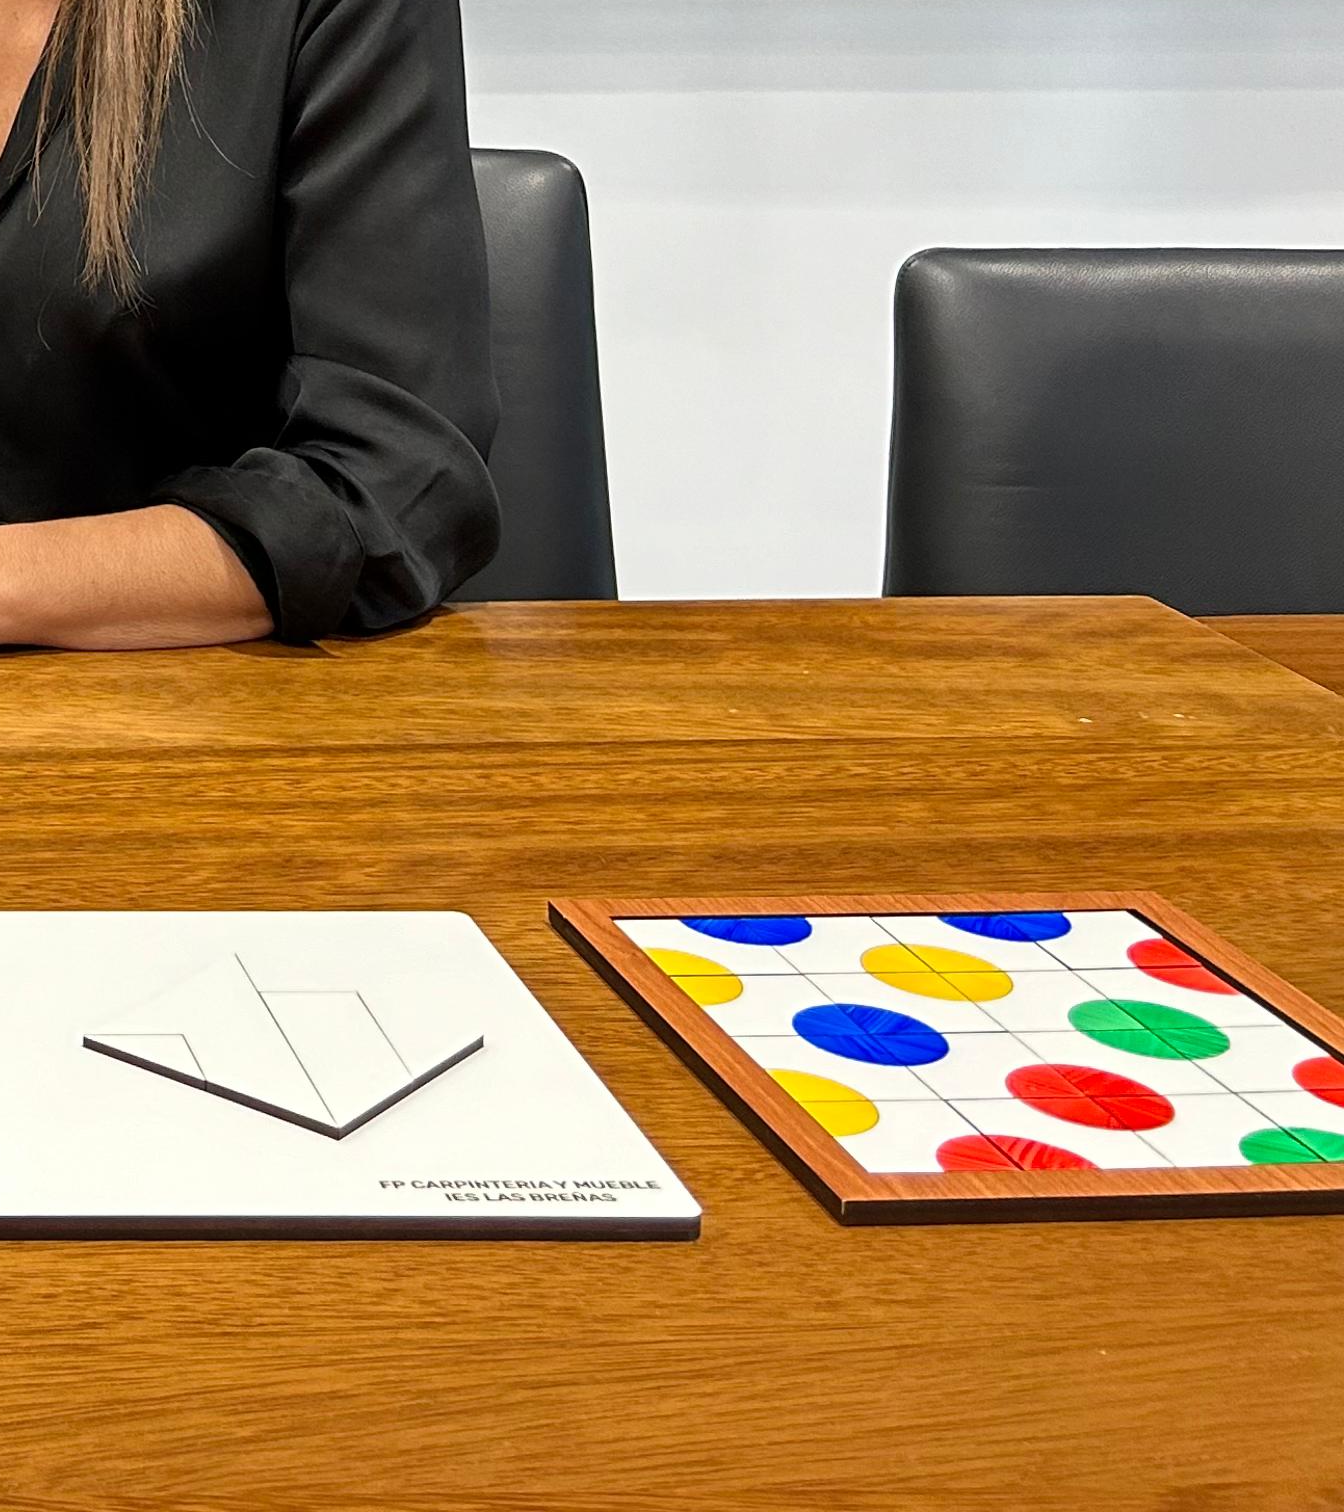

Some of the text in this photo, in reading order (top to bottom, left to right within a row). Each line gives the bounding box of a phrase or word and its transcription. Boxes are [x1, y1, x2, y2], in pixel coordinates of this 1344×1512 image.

[378, 1179, 406, 1190] FP
[572, 1179, 662, 1190] MUEBLE
[444, 1190, 618, 1202] IES LAS BREÑAS
